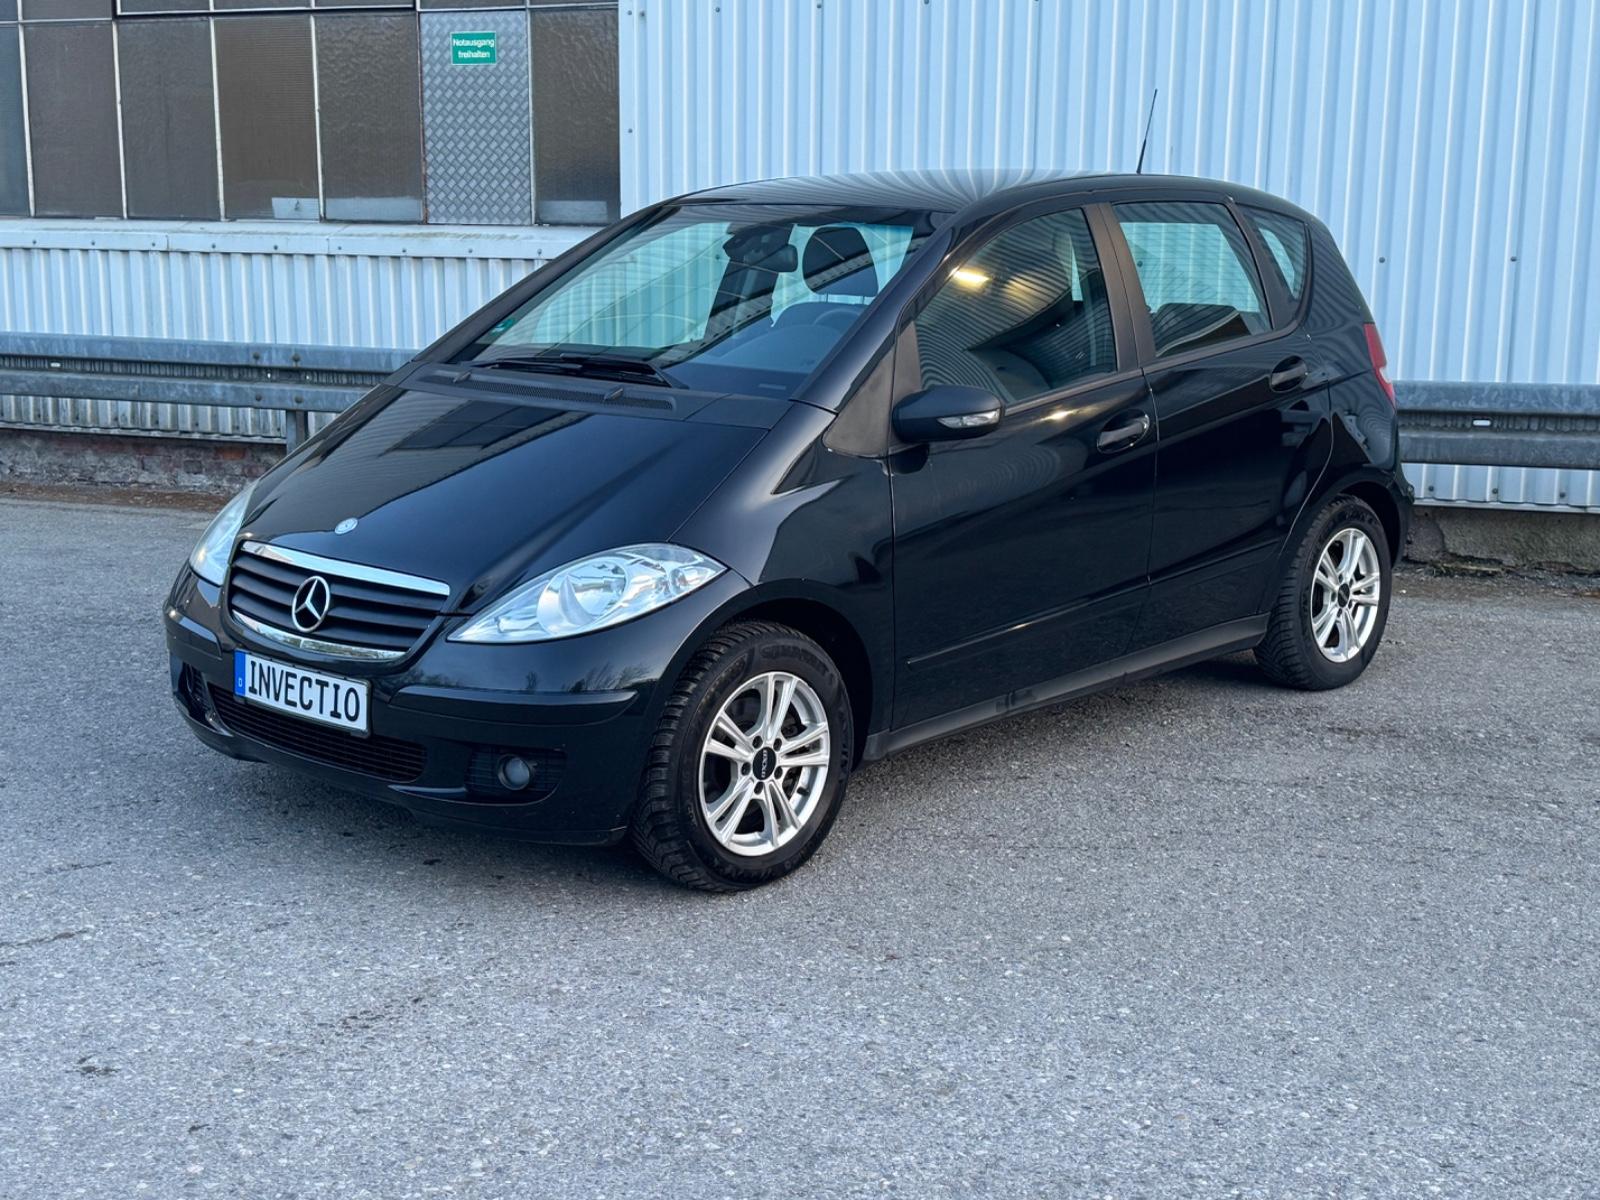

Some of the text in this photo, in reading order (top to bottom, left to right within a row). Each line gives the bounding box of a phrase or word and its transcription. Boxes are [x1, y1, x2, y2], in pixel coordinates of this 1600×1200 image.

[453, 38, 495, 48] Notausgang
[458, 50, 490, 58] freihalten
[248, 660, 361, 722] INVECTIO
